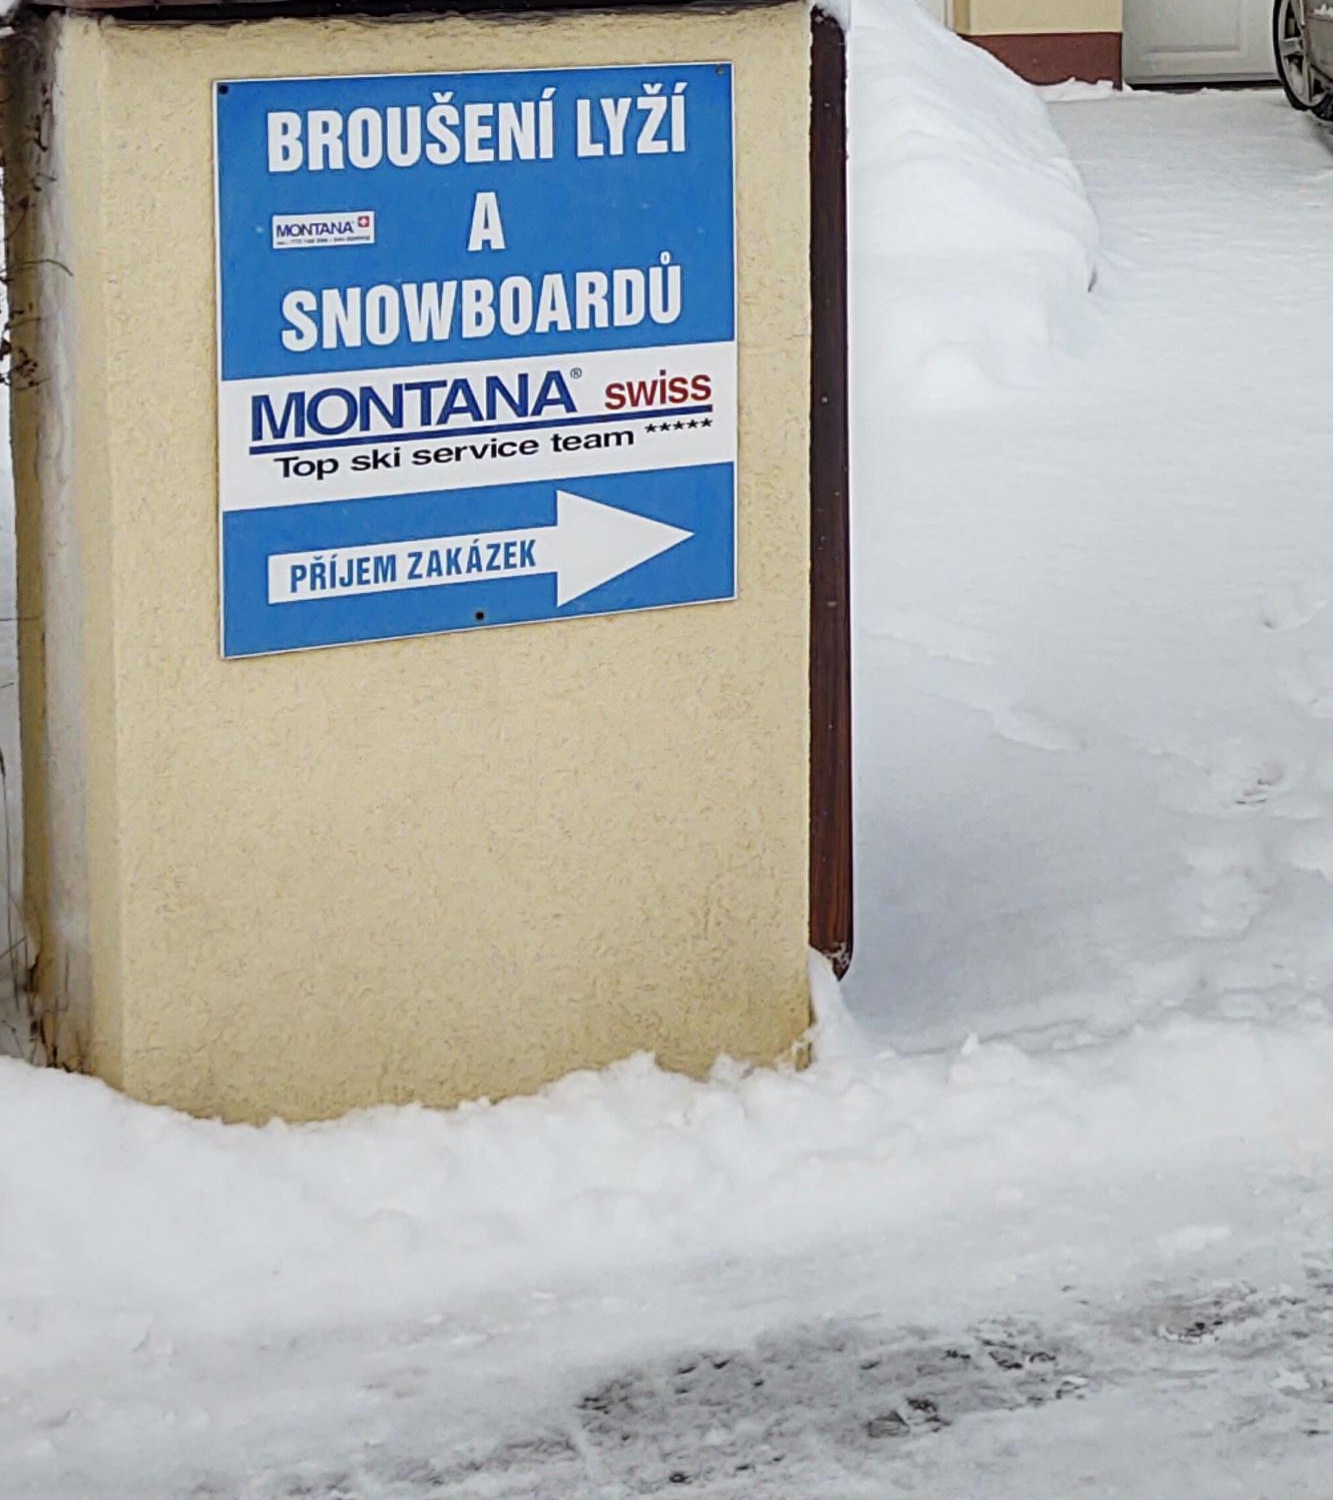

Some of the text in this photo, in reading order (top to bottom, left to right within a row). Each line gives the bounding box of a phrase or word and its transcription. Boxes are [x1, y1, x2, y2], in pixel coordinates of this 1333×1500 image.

[266, 82, 688, 173] BROUŠENÍ LYŽÍ
[276, 221, 353, 238] MONTANA
[467, 192, 506, 252] A
[281, 251, 682, 352] SNOWBOARDŮ
[604, 369, 713, 411] swiss
[275, 429, 635, 480] Top ski service team
[290, 538, 537, 593] PŘÍJEM ZAKÁZEK
